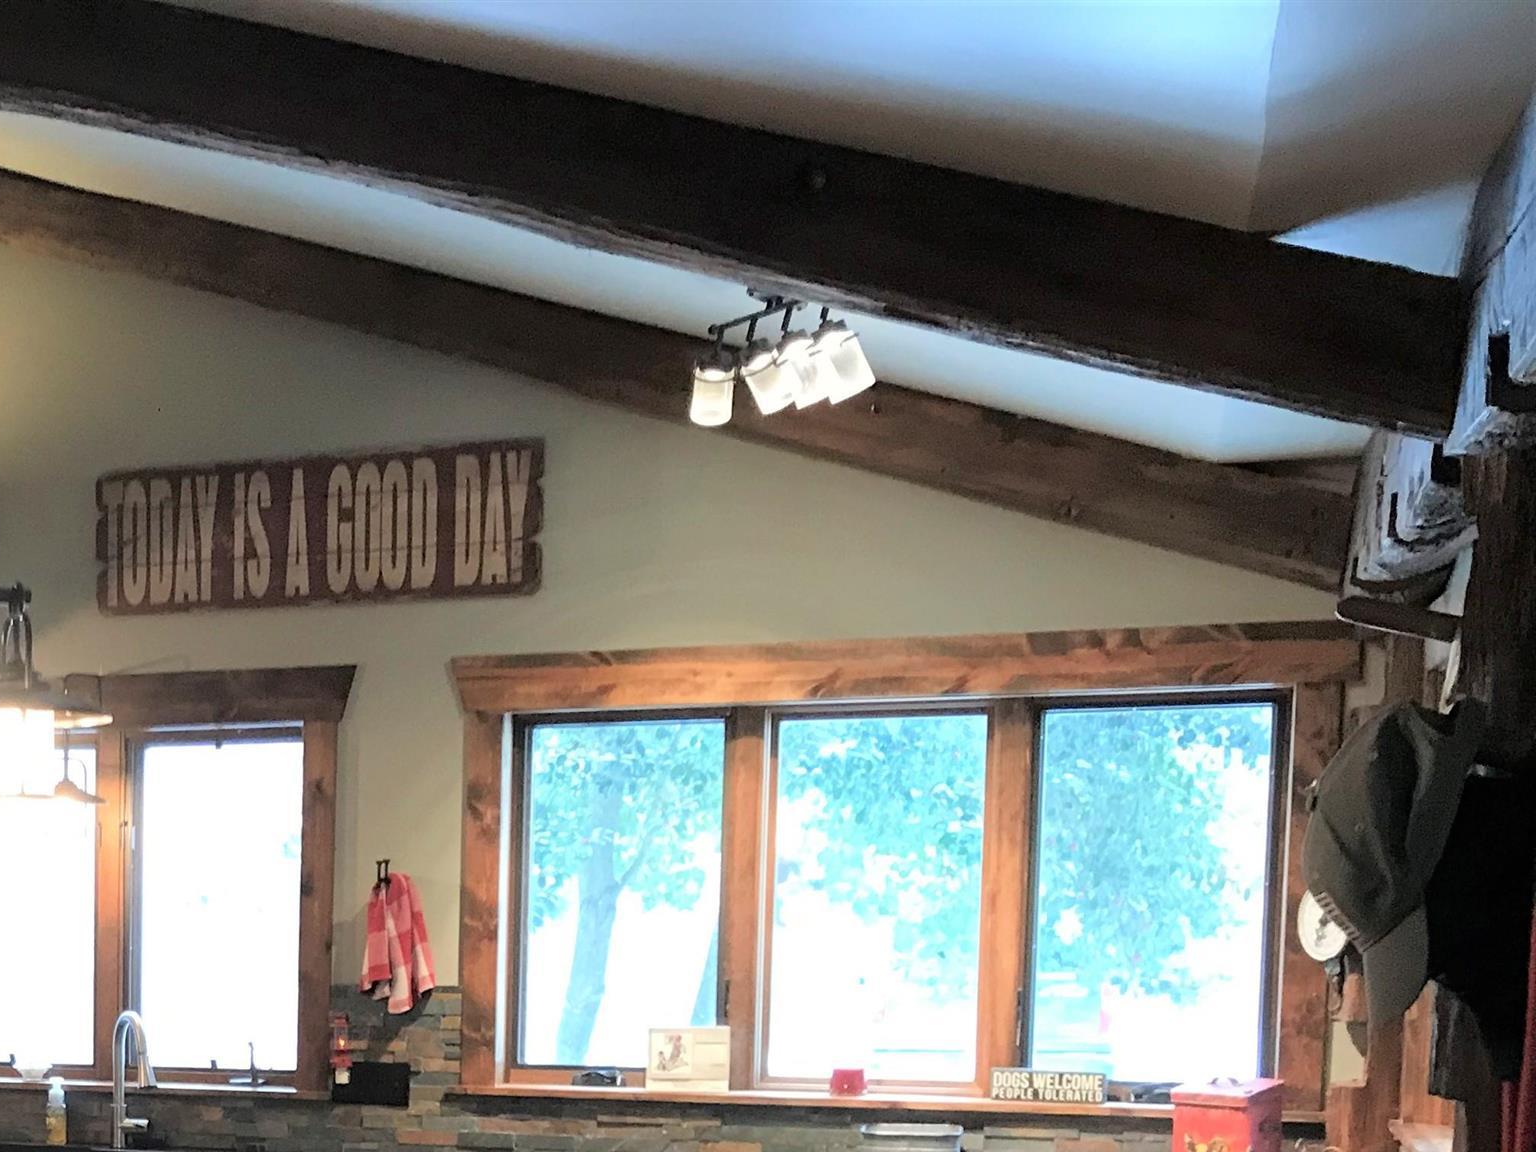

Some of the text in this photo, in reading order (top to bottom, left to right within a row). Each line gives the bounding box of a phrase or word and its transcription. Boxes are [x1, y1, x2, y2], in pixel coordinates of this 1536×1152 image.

[102, 450, 532, 606] TODAY IS A GOOD DAY
[992, 1072, 1103, 1090] DOGS WELCOME
[992, 1088, 1103, 1102] PEOPLE TOLERATED
